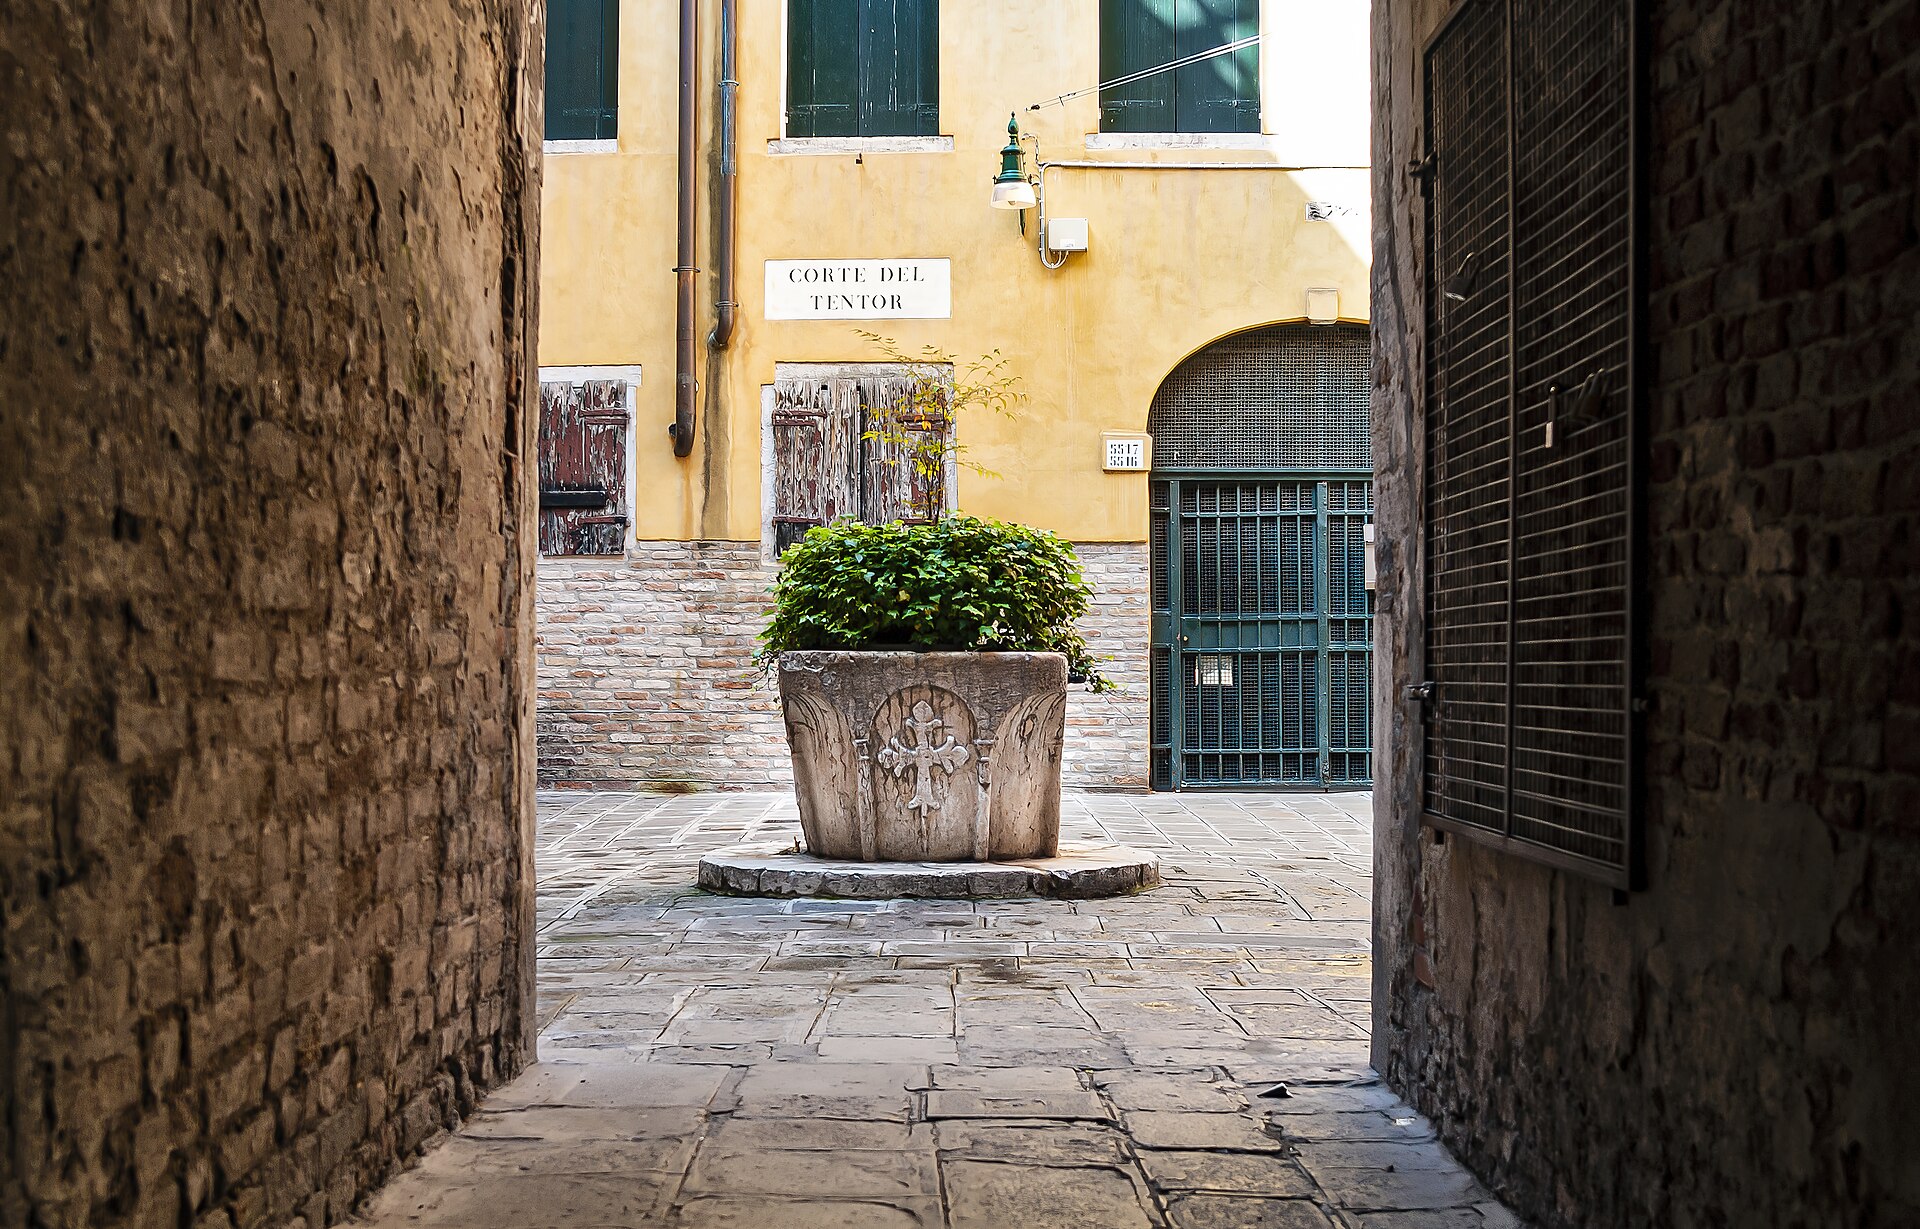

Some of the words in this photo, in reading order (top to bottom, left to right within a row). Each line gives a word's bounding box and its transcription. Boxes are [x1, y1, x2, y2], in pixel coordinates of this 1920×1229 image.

[789, 267, 866, 283] CORTE
[880, 266, 925, 283] DEL
[810, 294, 902, 310] TENTOR
[1110, 443, 1139, 455] 5517
